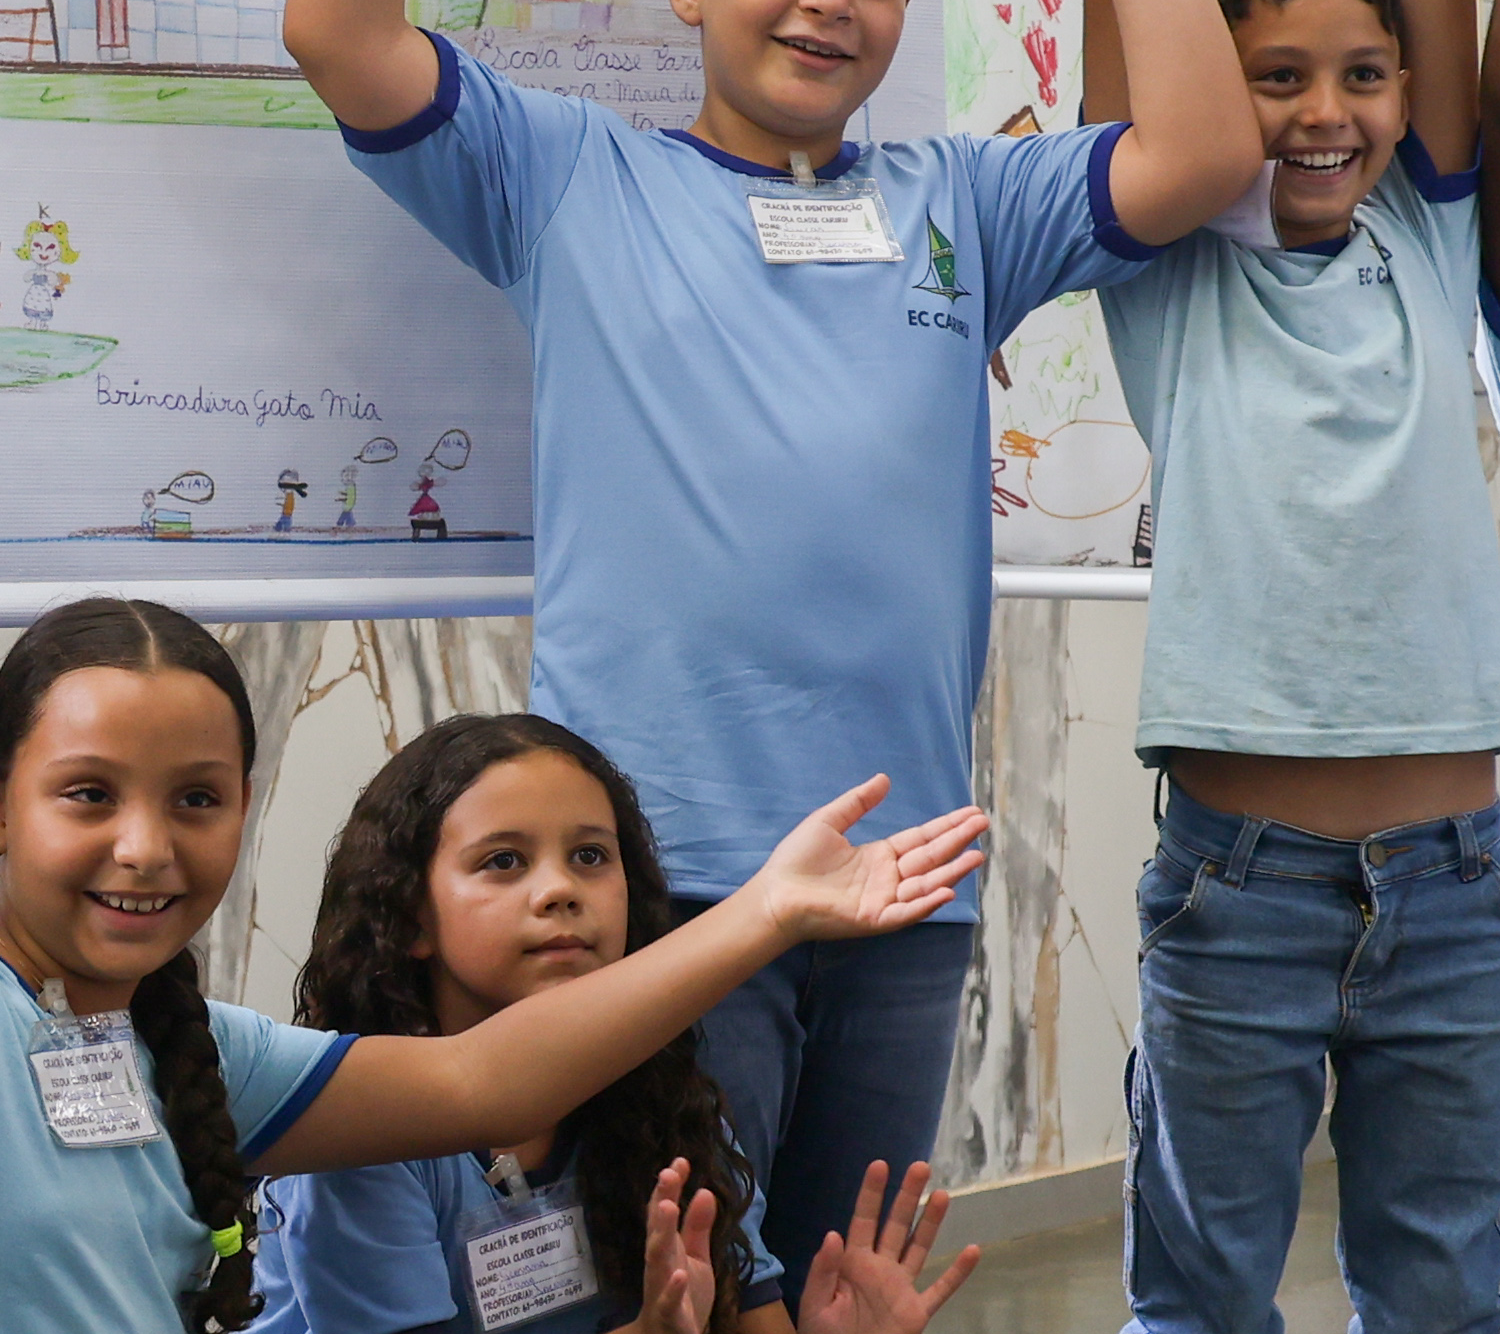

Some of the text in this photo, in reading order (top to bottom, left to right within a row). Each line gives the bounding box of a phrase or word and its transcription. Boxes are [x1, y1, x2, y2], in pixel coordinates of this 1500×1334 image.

[1357, 267, 1373, 286] EC
[907, 309, 930, 328] EC
[95, 373, 250, 419] Brincadeira
[508, 1233, 519, 1245] DE
